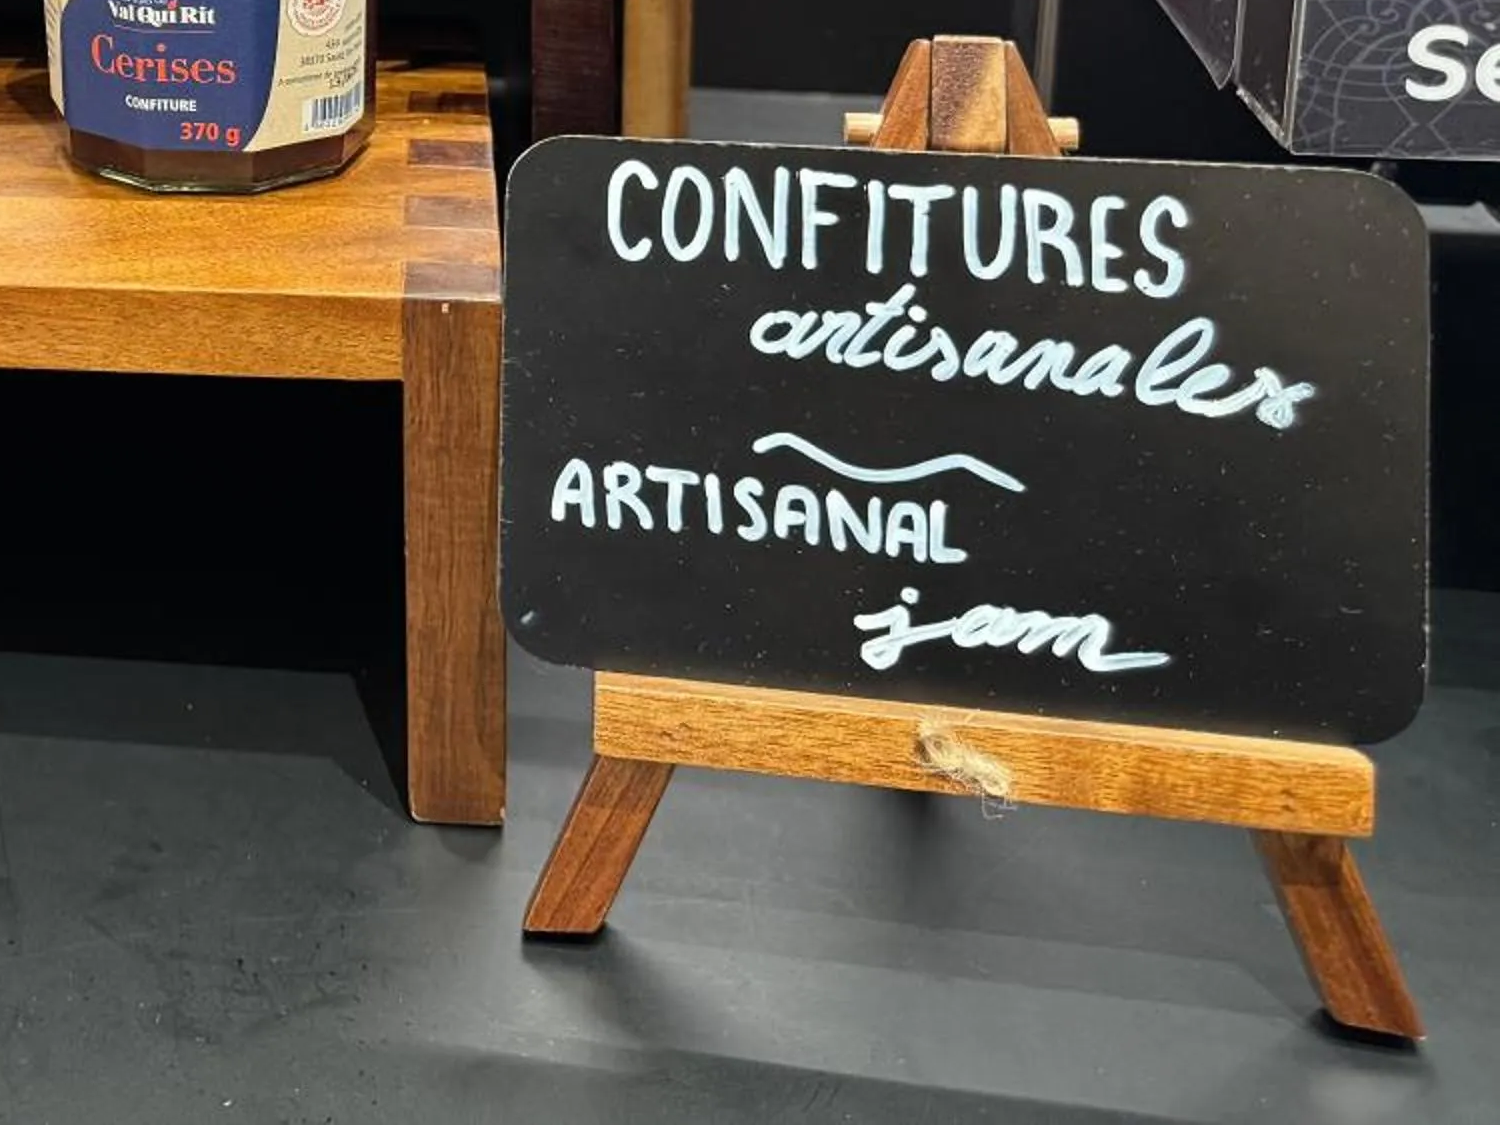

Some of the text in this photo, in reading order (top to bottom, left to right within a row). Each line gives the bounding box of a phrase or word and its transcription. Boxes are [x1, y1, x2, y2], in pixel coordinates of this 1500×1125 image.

[90, 34, 237, 84] Cerises
[125, 94, 197, 112] CONFITURE
[180, 123, 241, 147] 370 g
[608, 160, 1191, 298] CONFITURES
[750, 282, 1316, 430] artisanales
[551, 459, 967, 565] ARTISANAL
[853, 588, 1172, 673] jam
